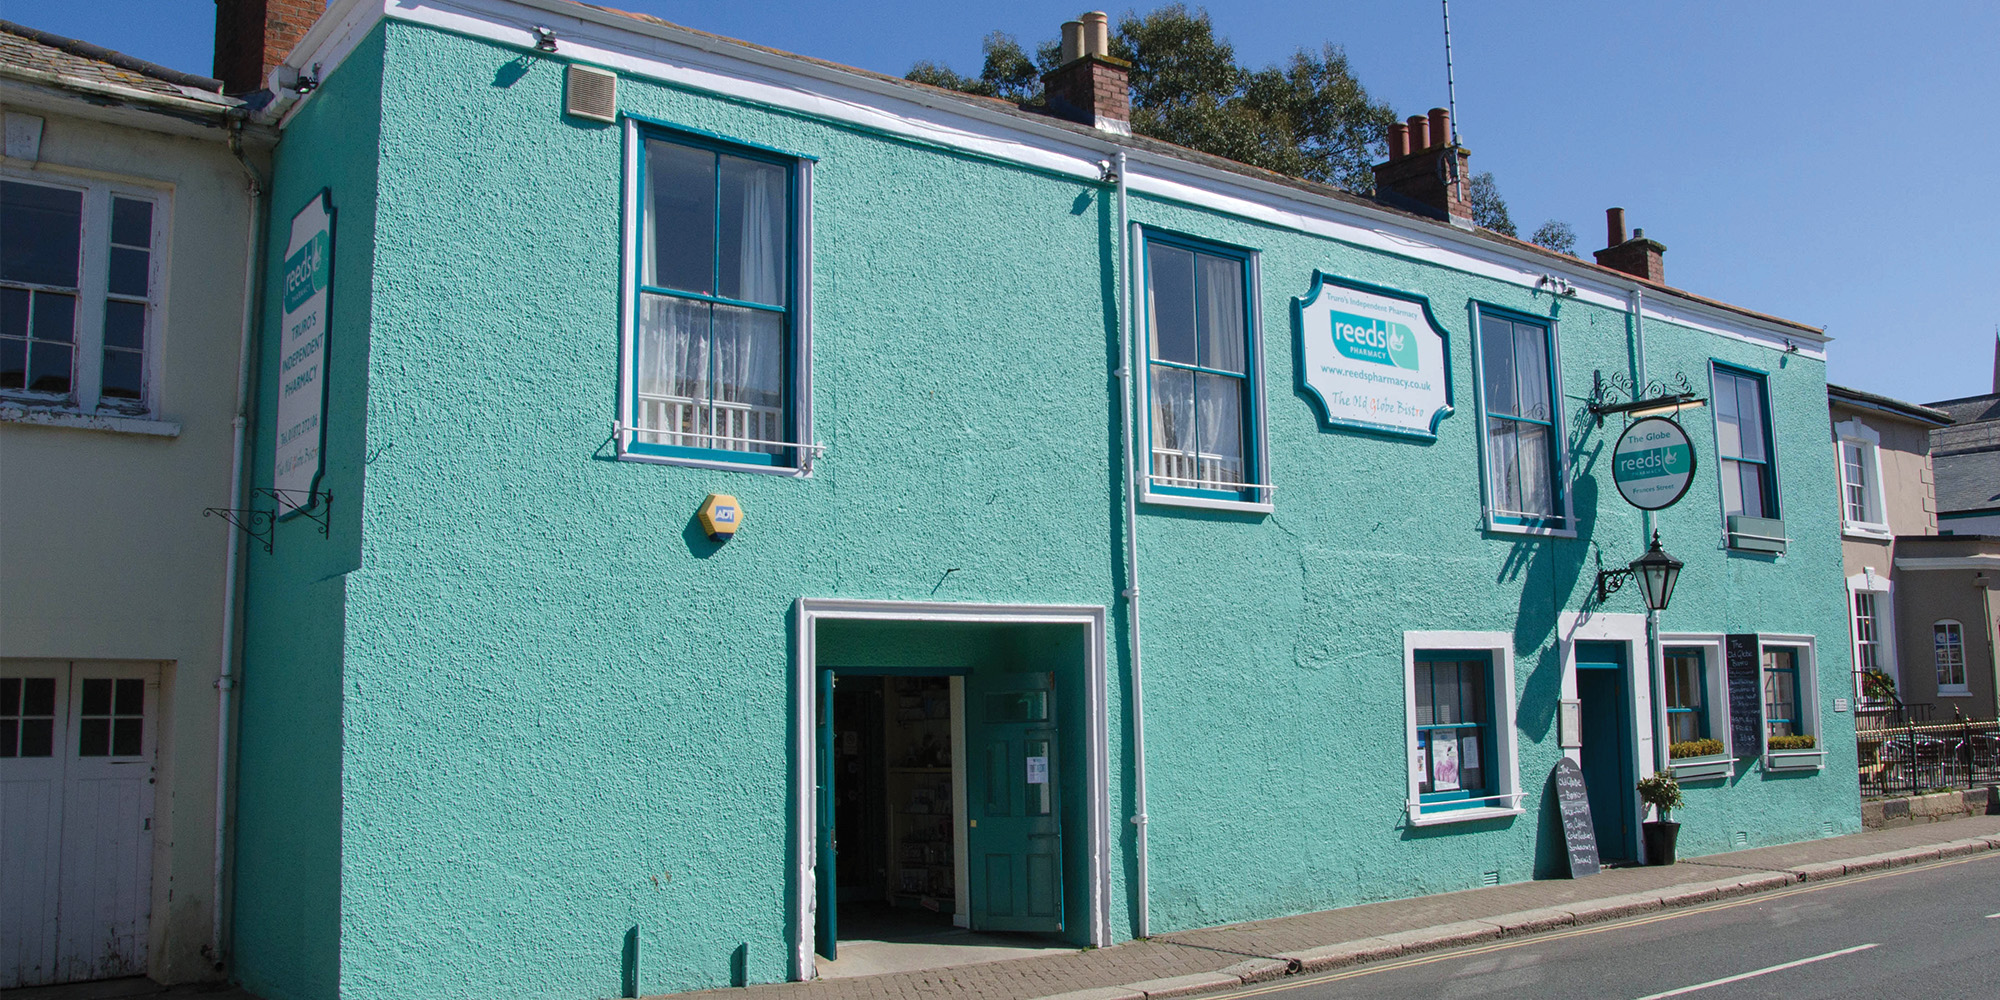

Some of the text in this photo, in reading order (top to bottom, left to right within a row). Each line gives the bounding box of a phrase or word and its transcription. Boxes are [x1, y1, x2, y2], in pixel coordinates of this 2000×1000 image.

[286, 245, 311, 296] reeds
[1327, 292, 1417, 320] Truro's Independent Pharmacy
[291, 311, 317, 342] TRURO'S
[1335, 320, 1386, 349] reeds
[282, 332, 324, 375] INDEPENDENT
[1350, 346, 1387, 360] PHARMACY
[285, 364, 318, 398] PHARMACY
[1321, 365, 1431, 391] www.reedspharmacy.co.uk
[1332, 391, 1424, 417] The Old Globe Bistro
[1627, 431, 1671, 444] The Globe
[1621, 450, 1661, 471] reeds
[1632, 486, 1655, 494] Frances
[715, 509, 734, 520] ADT
